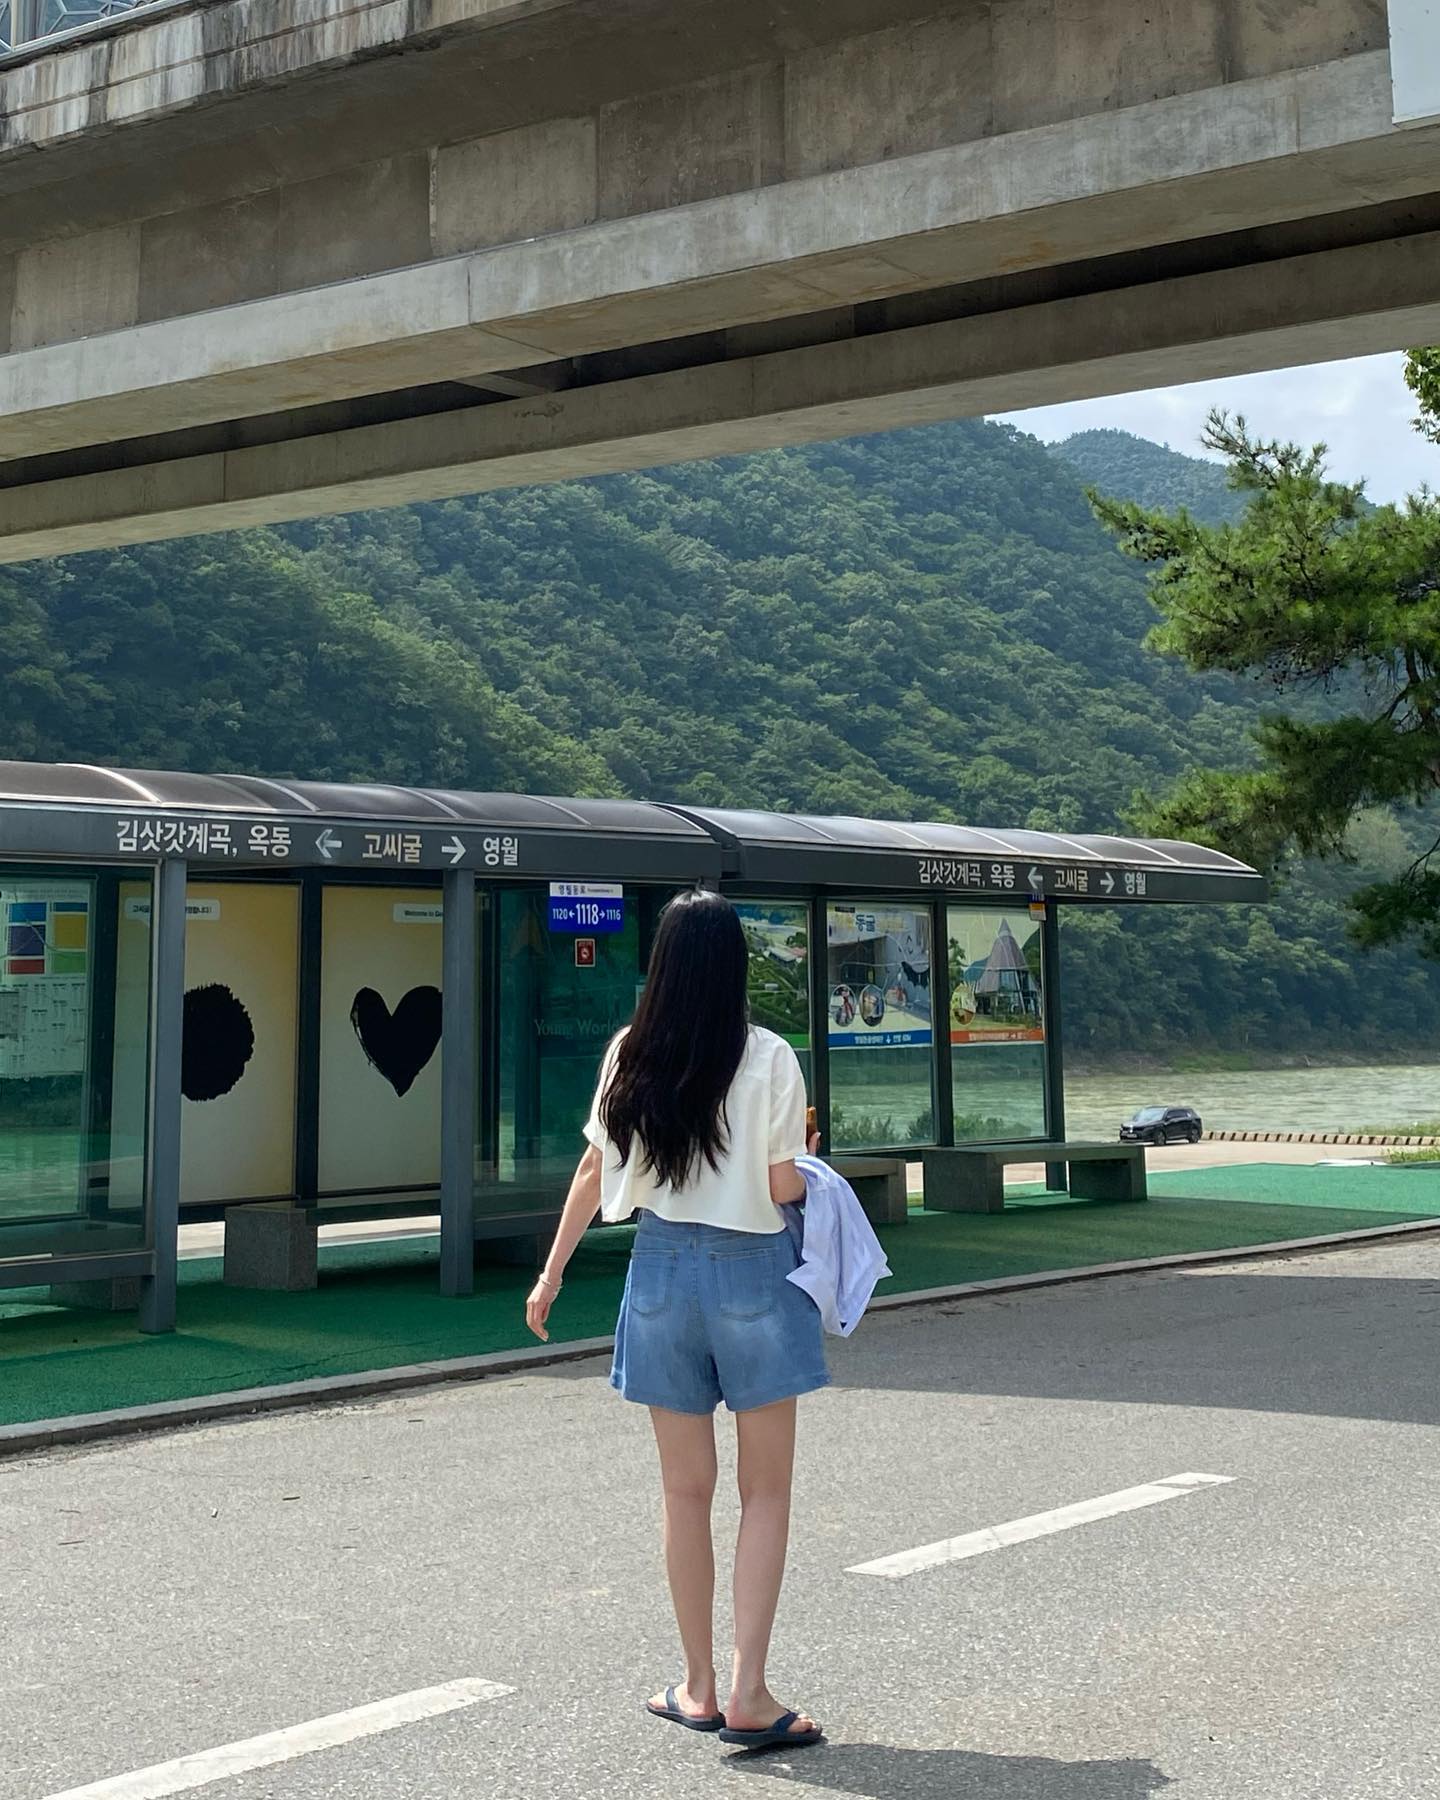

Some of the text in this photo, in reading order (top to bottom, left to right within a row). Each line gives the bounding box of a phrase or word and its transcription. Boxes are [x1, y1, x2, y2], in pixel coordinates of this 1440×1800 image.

[116, 819, 519, 866] 김삿갓계곡, 옥동 고씨굴 영월
[918, 860, 1147, 895] 김삿갓계곡, 옥동 고씨굴 영월
[552, 903, 622, 925] 1120 1118 1116
